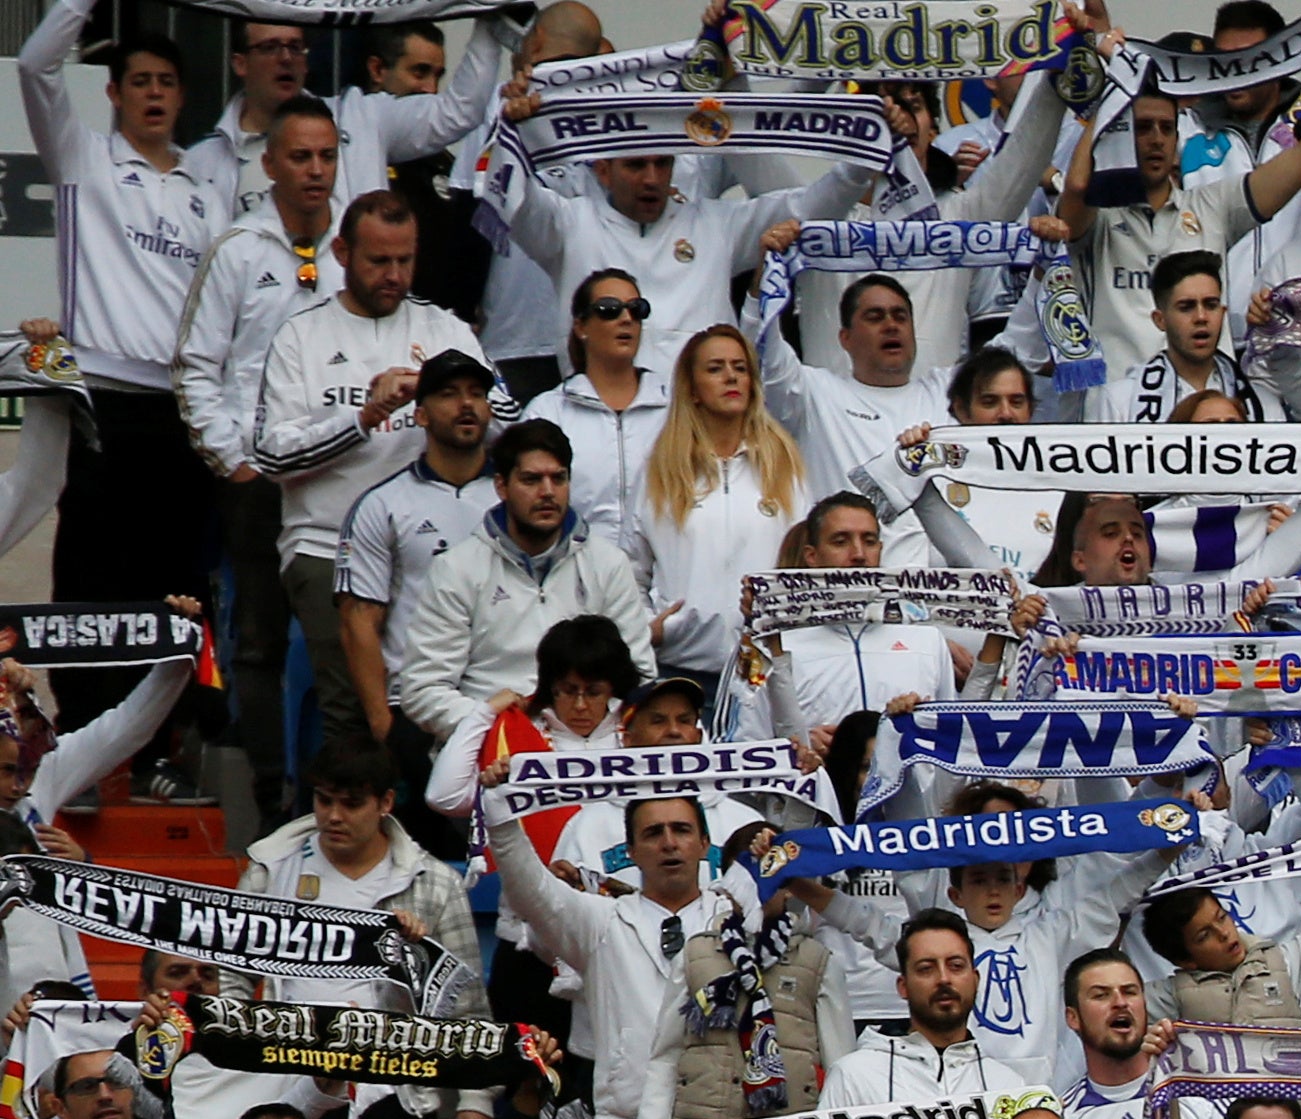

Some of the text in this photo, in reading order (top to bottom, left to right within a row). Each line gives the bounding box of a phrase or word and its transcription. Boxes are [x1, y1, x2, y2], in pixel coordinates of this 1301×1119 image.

[741, 2, 1062, 68] Madrid
[551, 109, 881, 142] REAL MADRID
[990, 433, 1299, 476] Madridista
[1233, 642, 1259, 660] 33
[827, 810, 1108, 856] Madridista
[202, 995, 506, 1058] Real Madrid
[262, 1043, 438, 1078] siempre fieles
